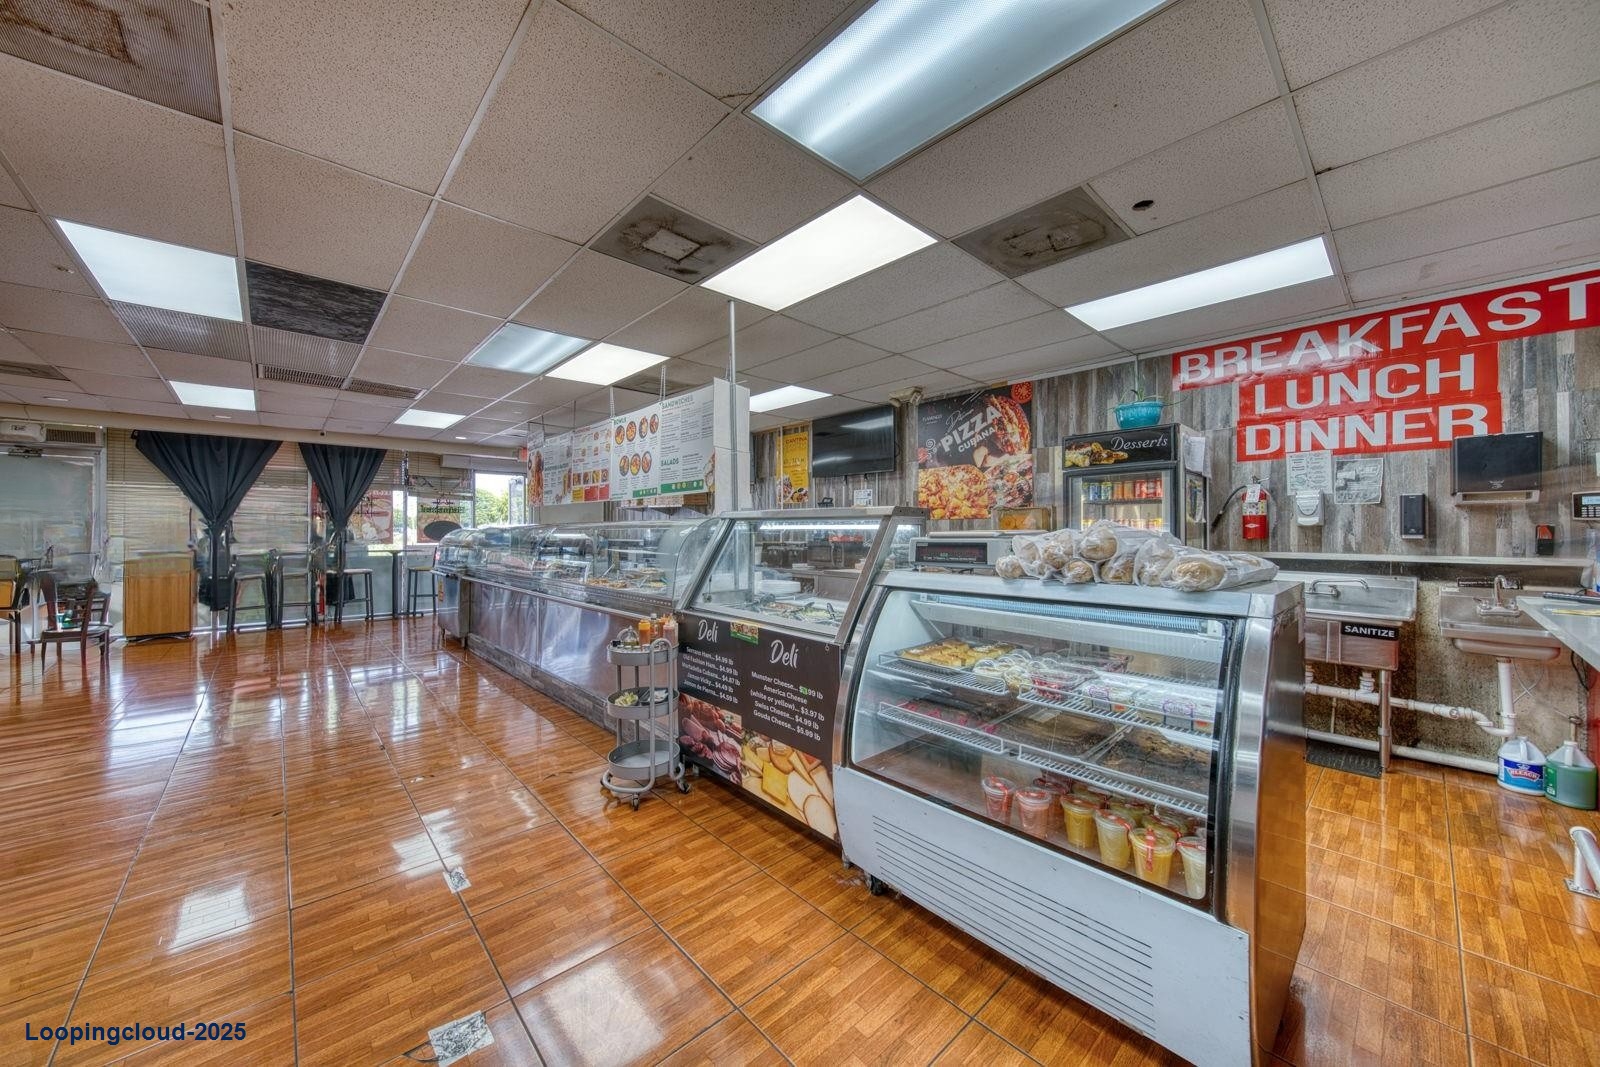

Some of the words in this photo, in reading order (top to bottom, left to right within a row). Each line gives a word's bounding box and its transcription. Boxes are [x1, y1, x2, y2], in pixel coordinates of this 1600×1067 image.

[1179, 276, 1600, 383] BREAKFAST
[1255, 353, 1475, 415] LUNCH
[940, 405, 1002, 453] PIZZA
[958, 426, 996, 453] CUBANA
[1111, 434, 1169, 451] Desserts
[1246, 403, 1488, 456] DINNER
[697, 619, 719, 643] Deli
[1344, 625, 1395, 638] SANITIZE
[769, 639, 799, 668] Deli
[763, 684, 786, 697] America
[786, 692, 808, 705] Cheese
[816, 691, 823, 700] lb
[753, 709, 770, 721] Gouda
[796, 725, 813, 738] $5.99
[814, 731, 821, 741] lb
[754, 700, 769, 711] Swiss
[795, 714, 812, 727] $4.99
[812, 721, 819, 730] lb
[800, 706, 817, 718] $3.97
[817, 712, 825, 721] lb
